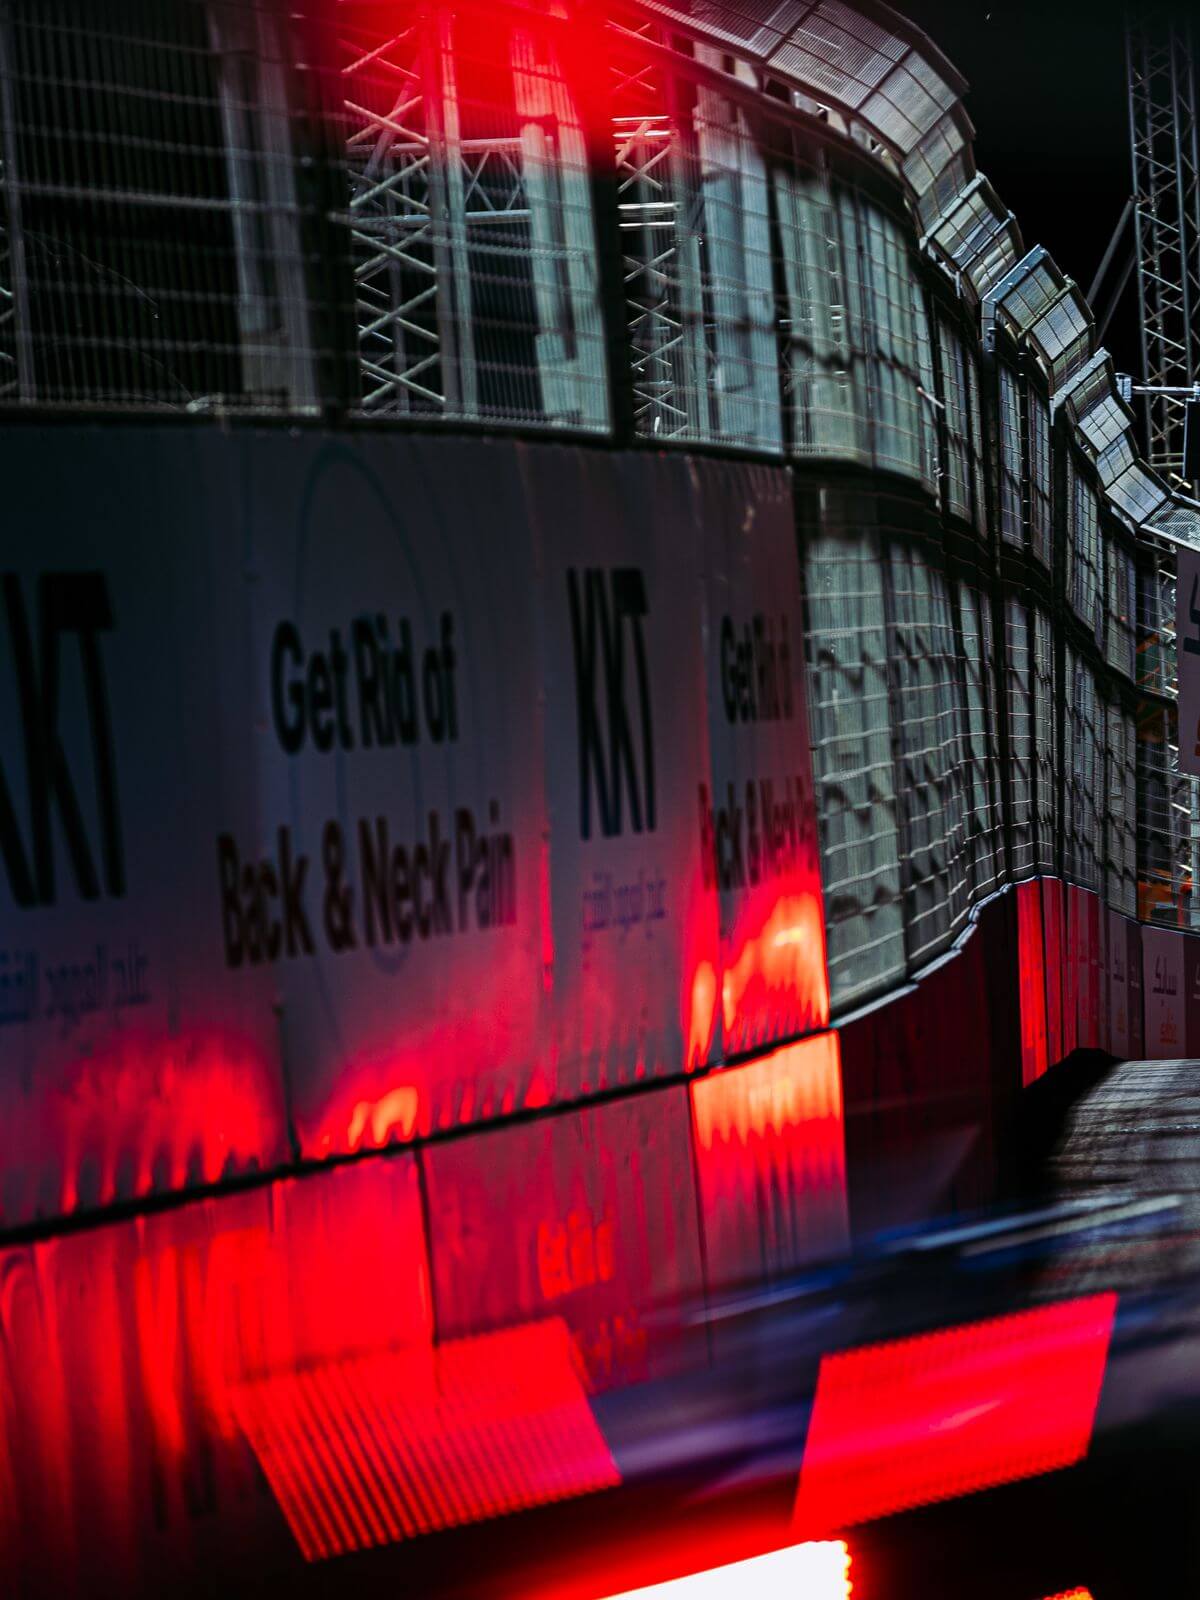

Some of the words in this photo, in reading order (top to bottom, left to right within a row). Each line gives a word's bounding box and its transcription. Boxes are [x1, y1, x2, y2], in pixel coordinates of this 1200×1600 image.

[271, 619, 353, 755] Get
[353, 611, 417, 748] Rid
[423, 611, 459, 744] of
[568, 567, 656, 840] KKT
[217, 826, 315, 967] Back
[321, 819, 357, 953] &
[358, 809, 451, 947] Neck
[455, 798, 516, 934] Pain
